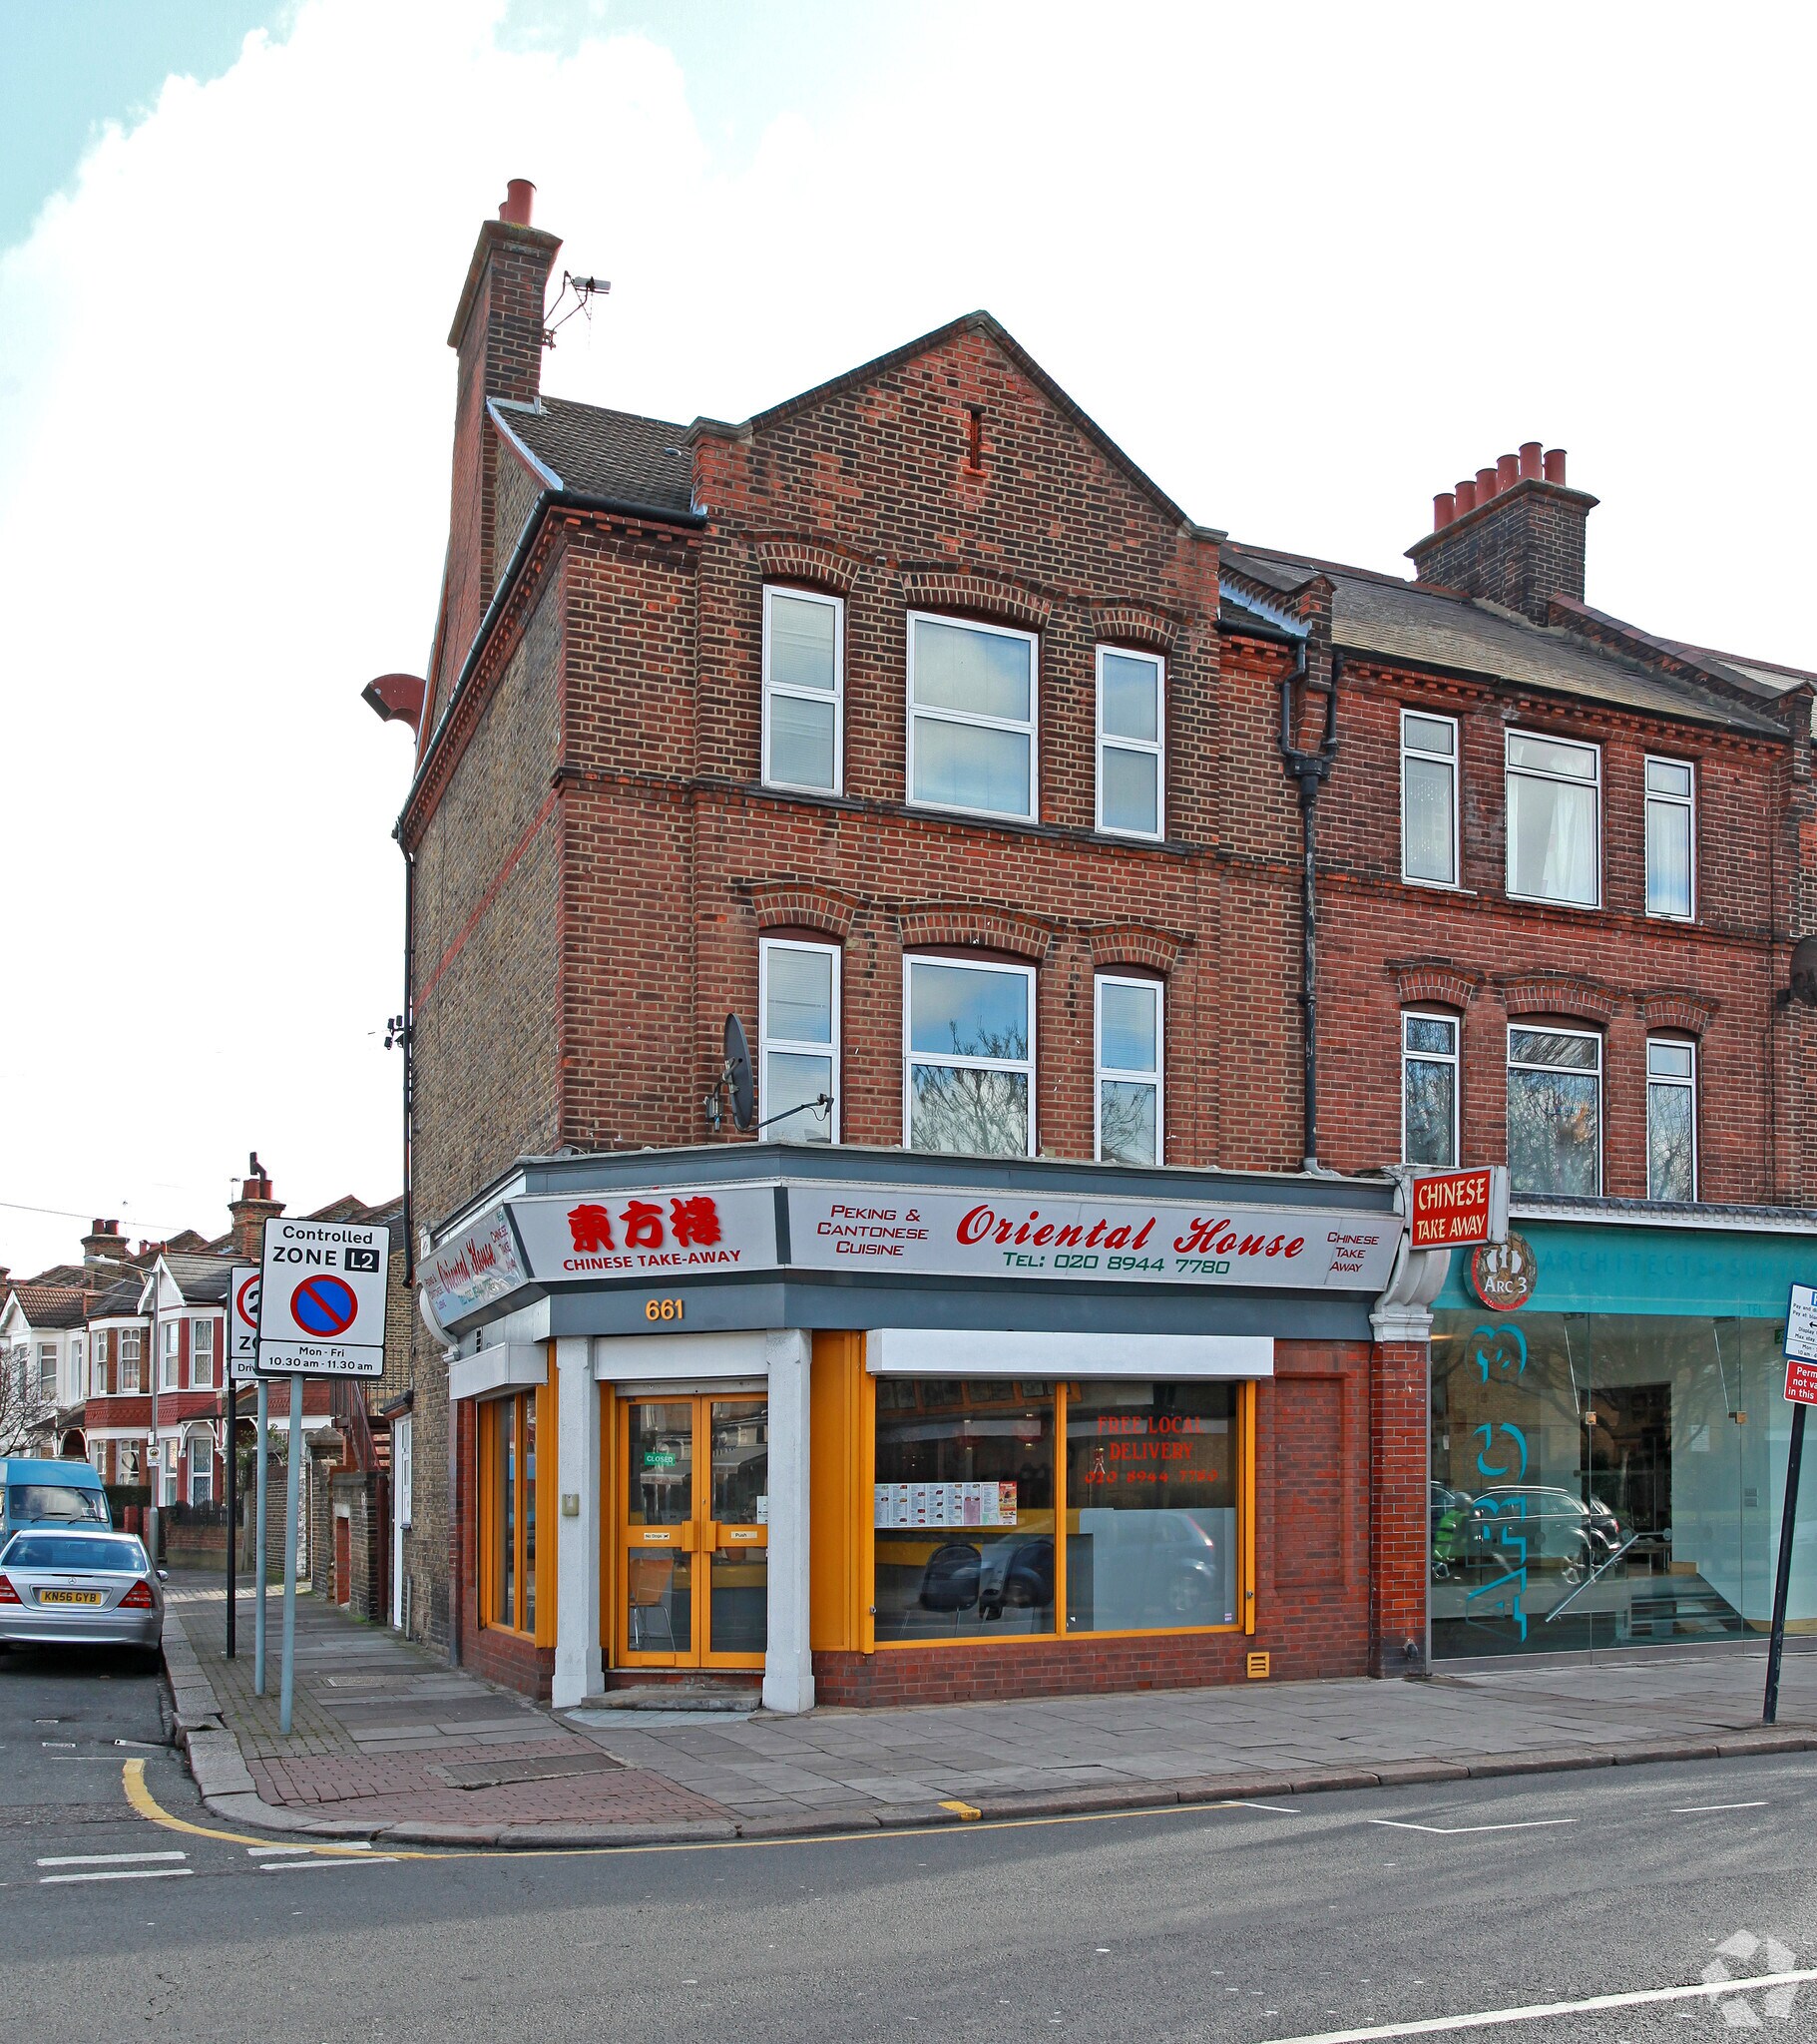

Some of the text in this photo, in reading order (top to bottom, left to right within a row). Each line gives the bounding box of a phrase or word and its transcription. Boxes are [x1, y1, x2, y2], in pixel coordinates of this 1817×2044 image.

[1418, 1178, 1486, 1212] CHINESE
[830, 1205, 921, 1223] PEKING &
[282, 1226, 373, 1245] Controlled
[817, 1222, 929, 1241] CANTONESE
[956, 1204, 1305, 1259] Oriental House
[1416, 1213, 1487, 1241] TAKE AWAY
[1327, 1231, 1380, 1246] CHINESE
[835, 1241, 904, 1257] CUISINE
[1336, 1247, 1366, 1260] TAKE
[272, 1247, 374, 1270] ZONE L2
[437, 1249, 471, 1293] Oriental
[466, 1238, 497, 1276] House
[563, 1250, 741, 1271] CHINESE TAKE-AWAY
[1054, 1255, 1100, 1270] 020
[1107, 1256, 1165, 1272] 8944
[1175, 1259, 1231, 1275] 7780
[1329, 1261, 1363, 1273] AWAY
[1518, 1277, 1528, 1293] 3
[645, 1298, 684, 1320] 661
[299, 1346, 322, 1356] Mon
[330, 1348, 345, 1357] Fri
[269, 1357, 300, 1366] 10.30
[327, 1361, 355, 1370] 11.30
[1793, 1378, 1807, 1387] not
[1788, 1386, 1814, 1400] in this
[1099, 1415, 1204, 1434] FREE LOCAL
[1110, 1441, 1193, 1461] DELIVERY
[1085, 1470, 1118, 1485] 020
[44, 1591, 97, 1603] KN56 GYB
